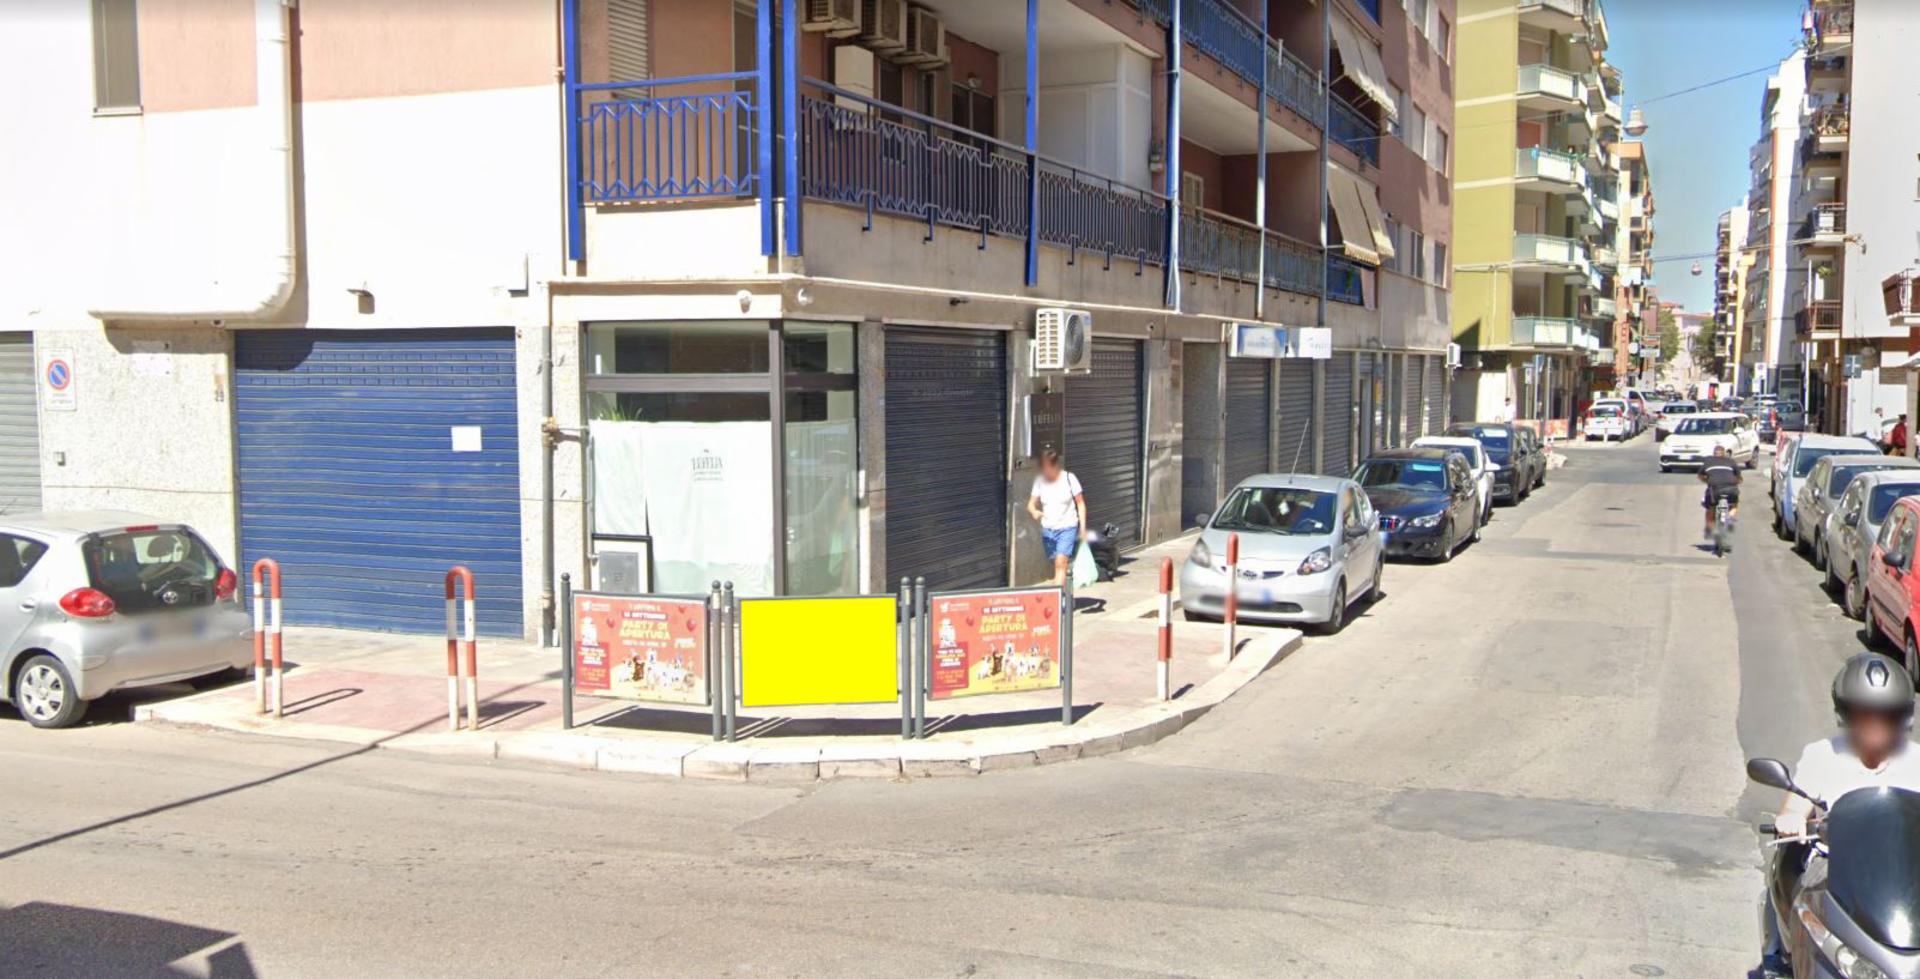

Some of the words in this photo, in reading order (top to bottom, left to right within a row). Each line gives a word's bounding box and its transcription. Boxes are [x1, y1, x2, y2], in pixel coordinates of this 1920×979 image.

[981, 615, 1013, 624] PARTY
[622, 620, 654, 630] PARTY
[978, 622, 1028, 633] APERTURA
[619, 628, 671, 640] APERTURA
